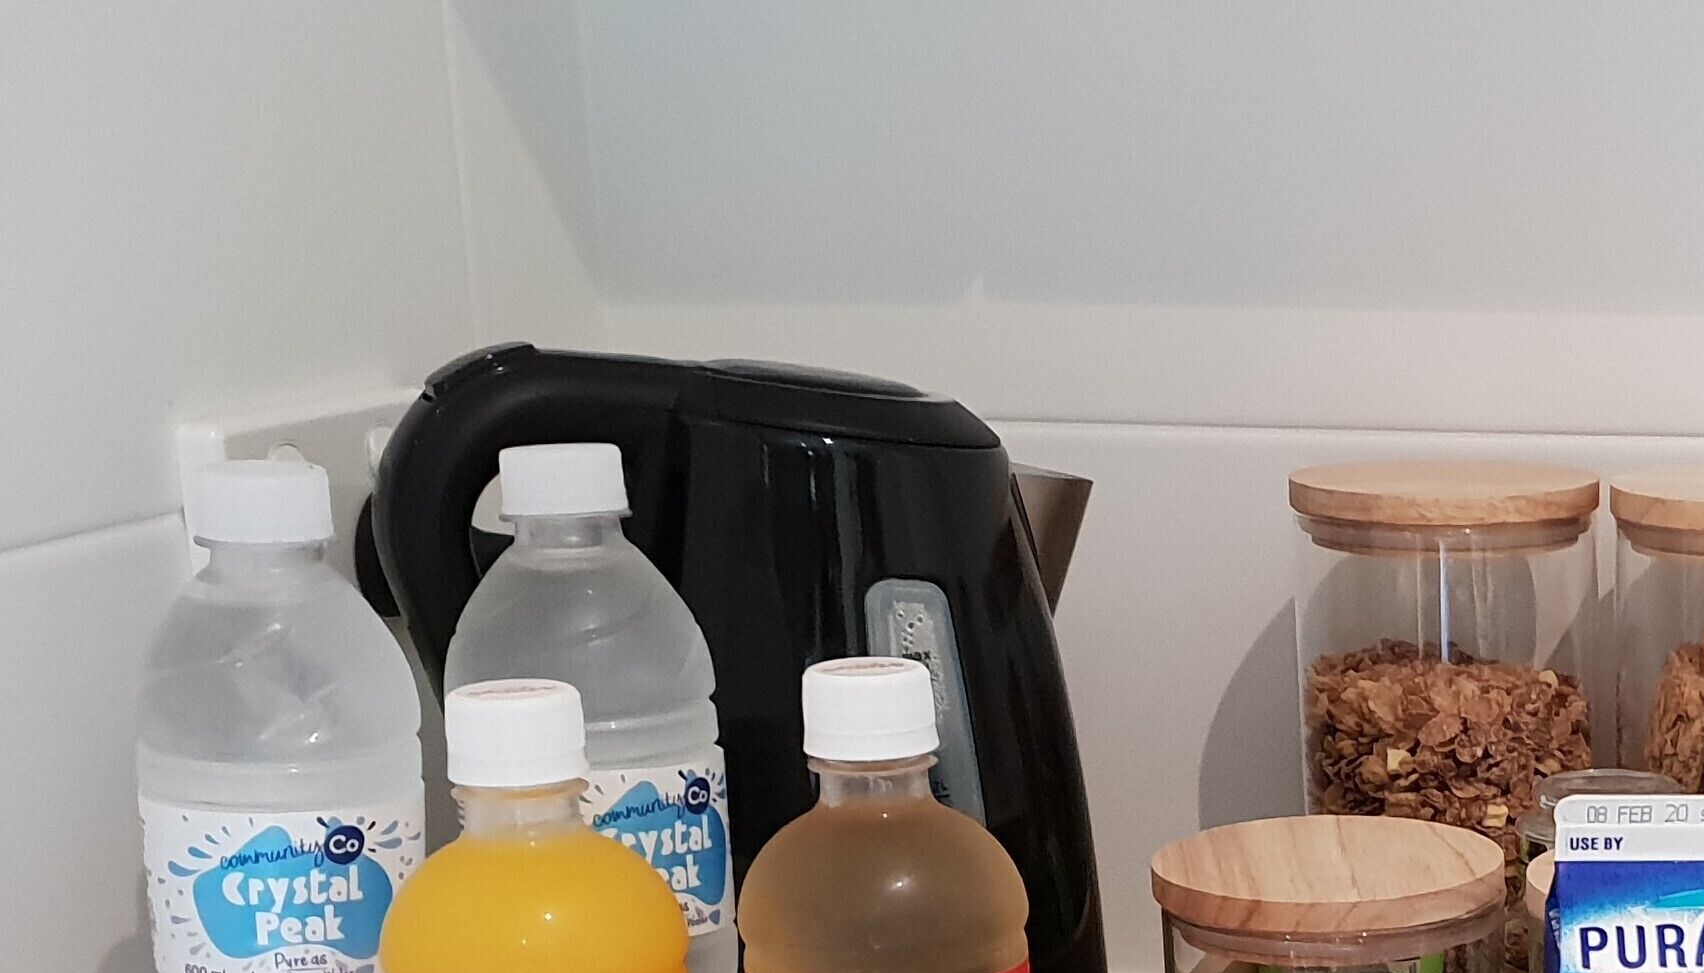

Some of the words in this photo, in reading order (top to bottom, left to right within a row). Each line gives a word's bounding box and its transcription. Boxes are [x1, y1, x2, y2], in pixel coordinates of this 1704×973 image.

[593, 791, 686, 828] community
[688, 786, 709, 805] Co
[1587, 805, 1608, 823] 08
[1617, 805, 1652, 824] FEB
[1664, 803, 1689, 823] 20
[219, 837, 326, 870] community
[328, 834, 360, 855] Co
[1569, 837, 1599, 851] USE
[1603, 836, 1624, 850] BY
[221, 864, 365, 914] Crystal
[255, 904, 346, 946] Peak
